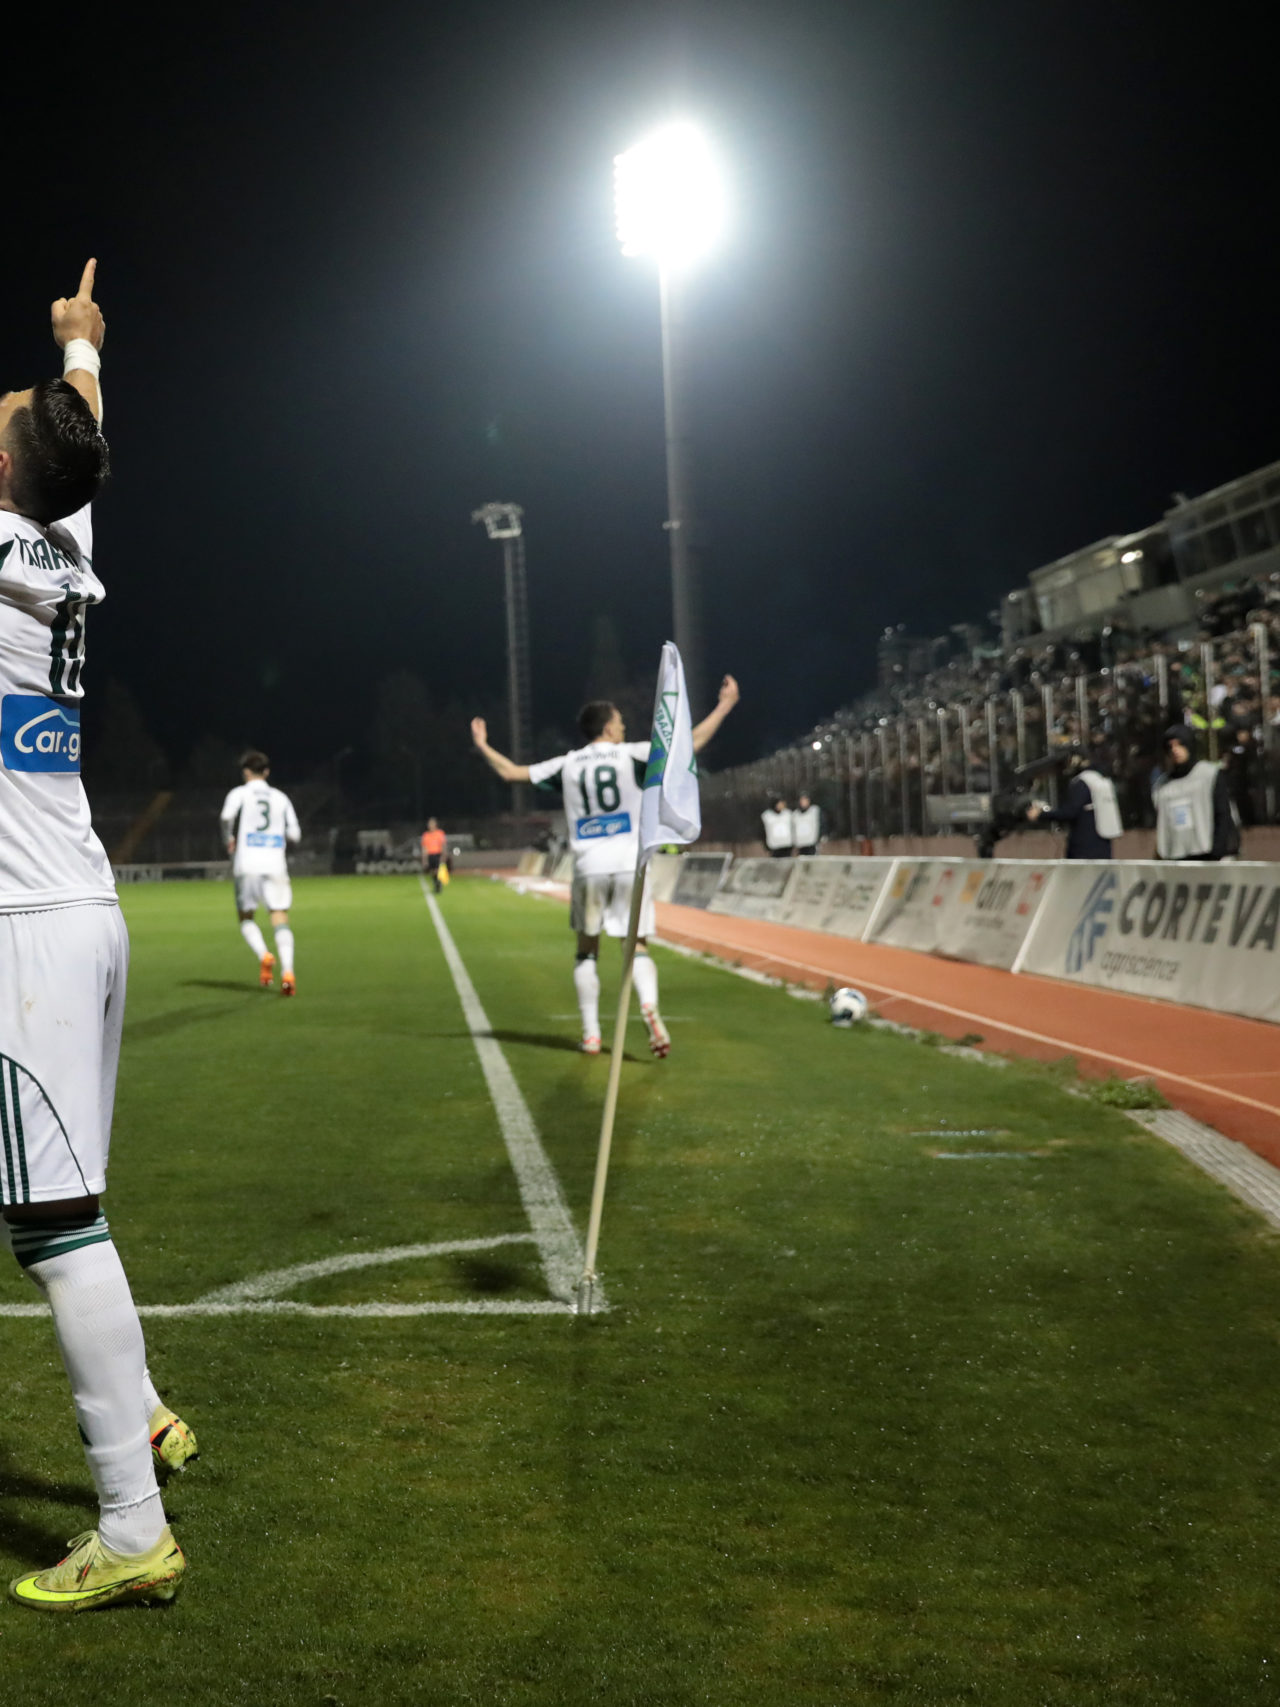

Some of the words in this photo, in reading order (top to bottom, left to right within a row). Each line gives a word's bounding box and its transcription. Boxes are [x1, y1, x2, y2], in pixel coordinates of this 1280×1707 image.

[14, 709, 81, 762] Car.g
[257, 800, 270, 831] 3
[579, 765, 621, 815] 18
[1117, 880, 1280, 951] CORTEVA
